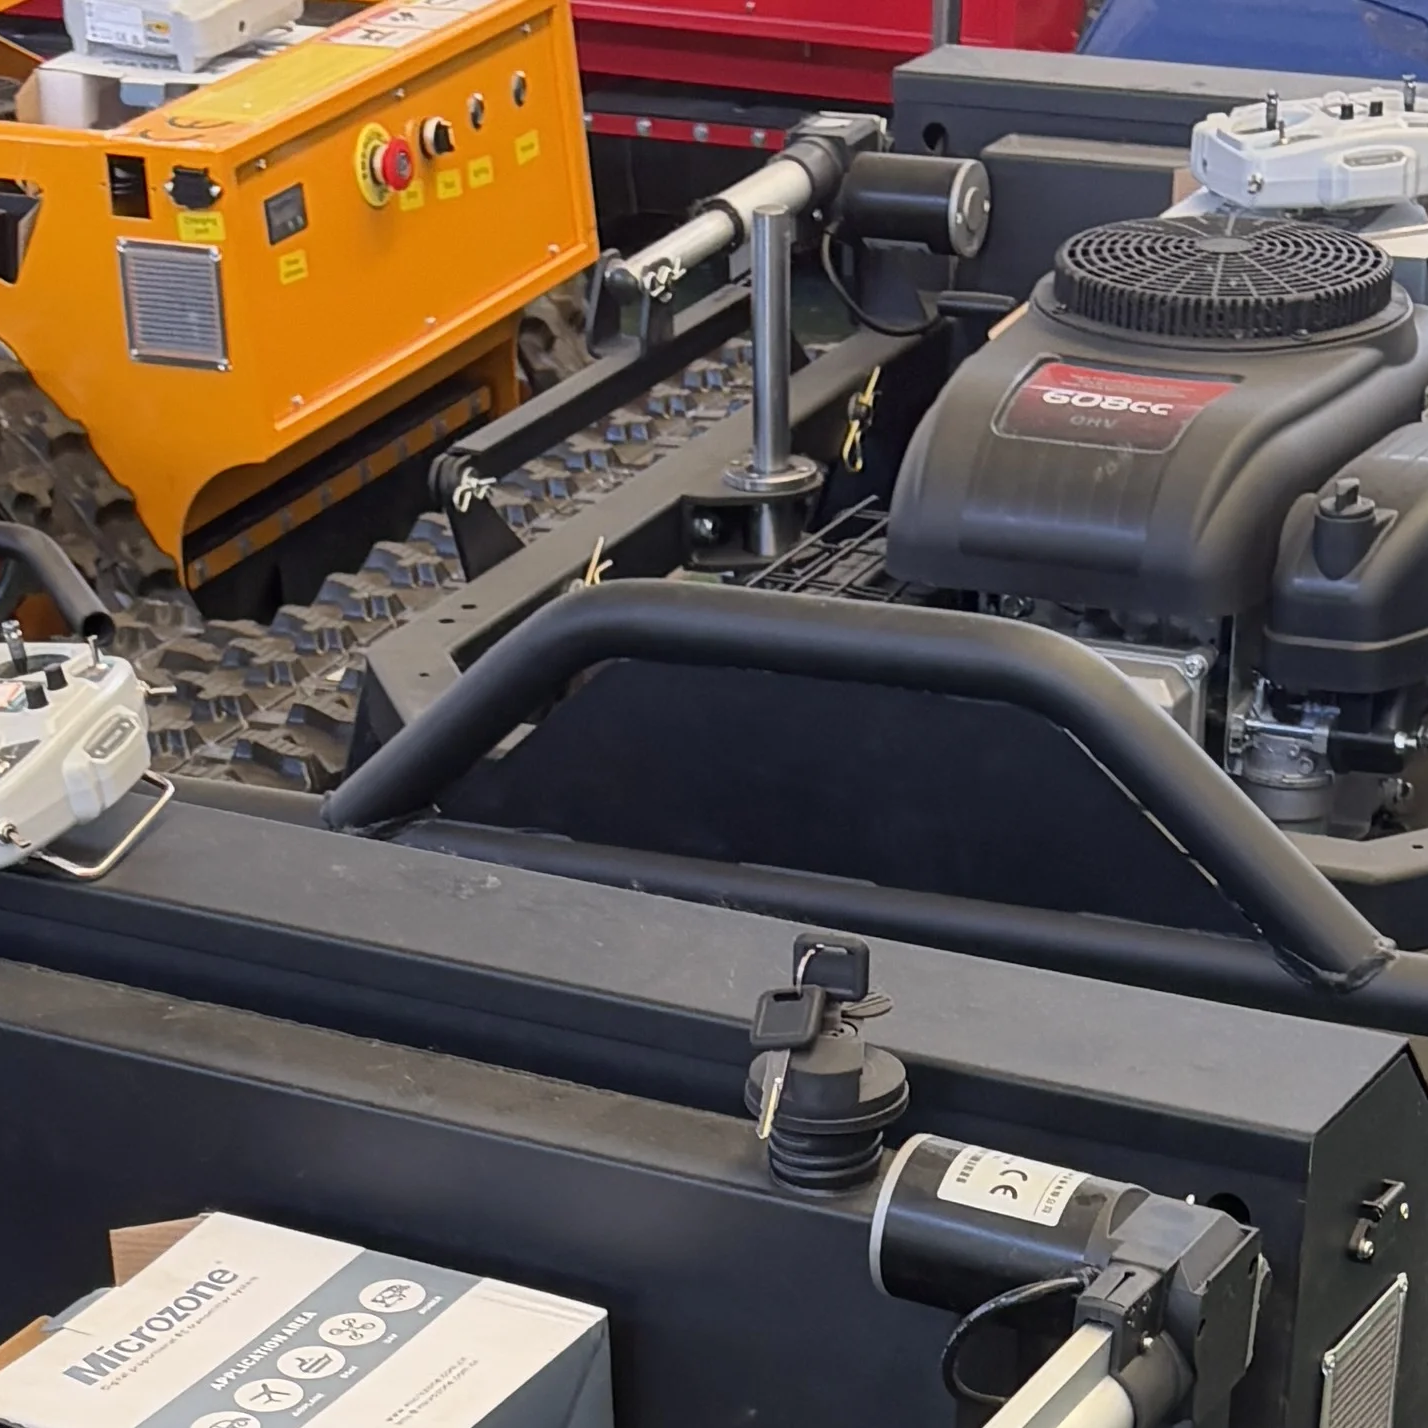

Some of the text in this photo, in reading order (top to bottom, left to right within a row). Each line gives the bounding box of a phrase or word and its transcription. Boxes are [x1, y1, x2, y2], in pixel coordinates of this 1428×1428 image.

[1042, 389, 1174, 416] 608cc
[989, 1168, 1028, 1200] CE
[62, 1267, 239, 1386] Microzone
[210, 1310, 319, 1392] APPLICATION AREA
